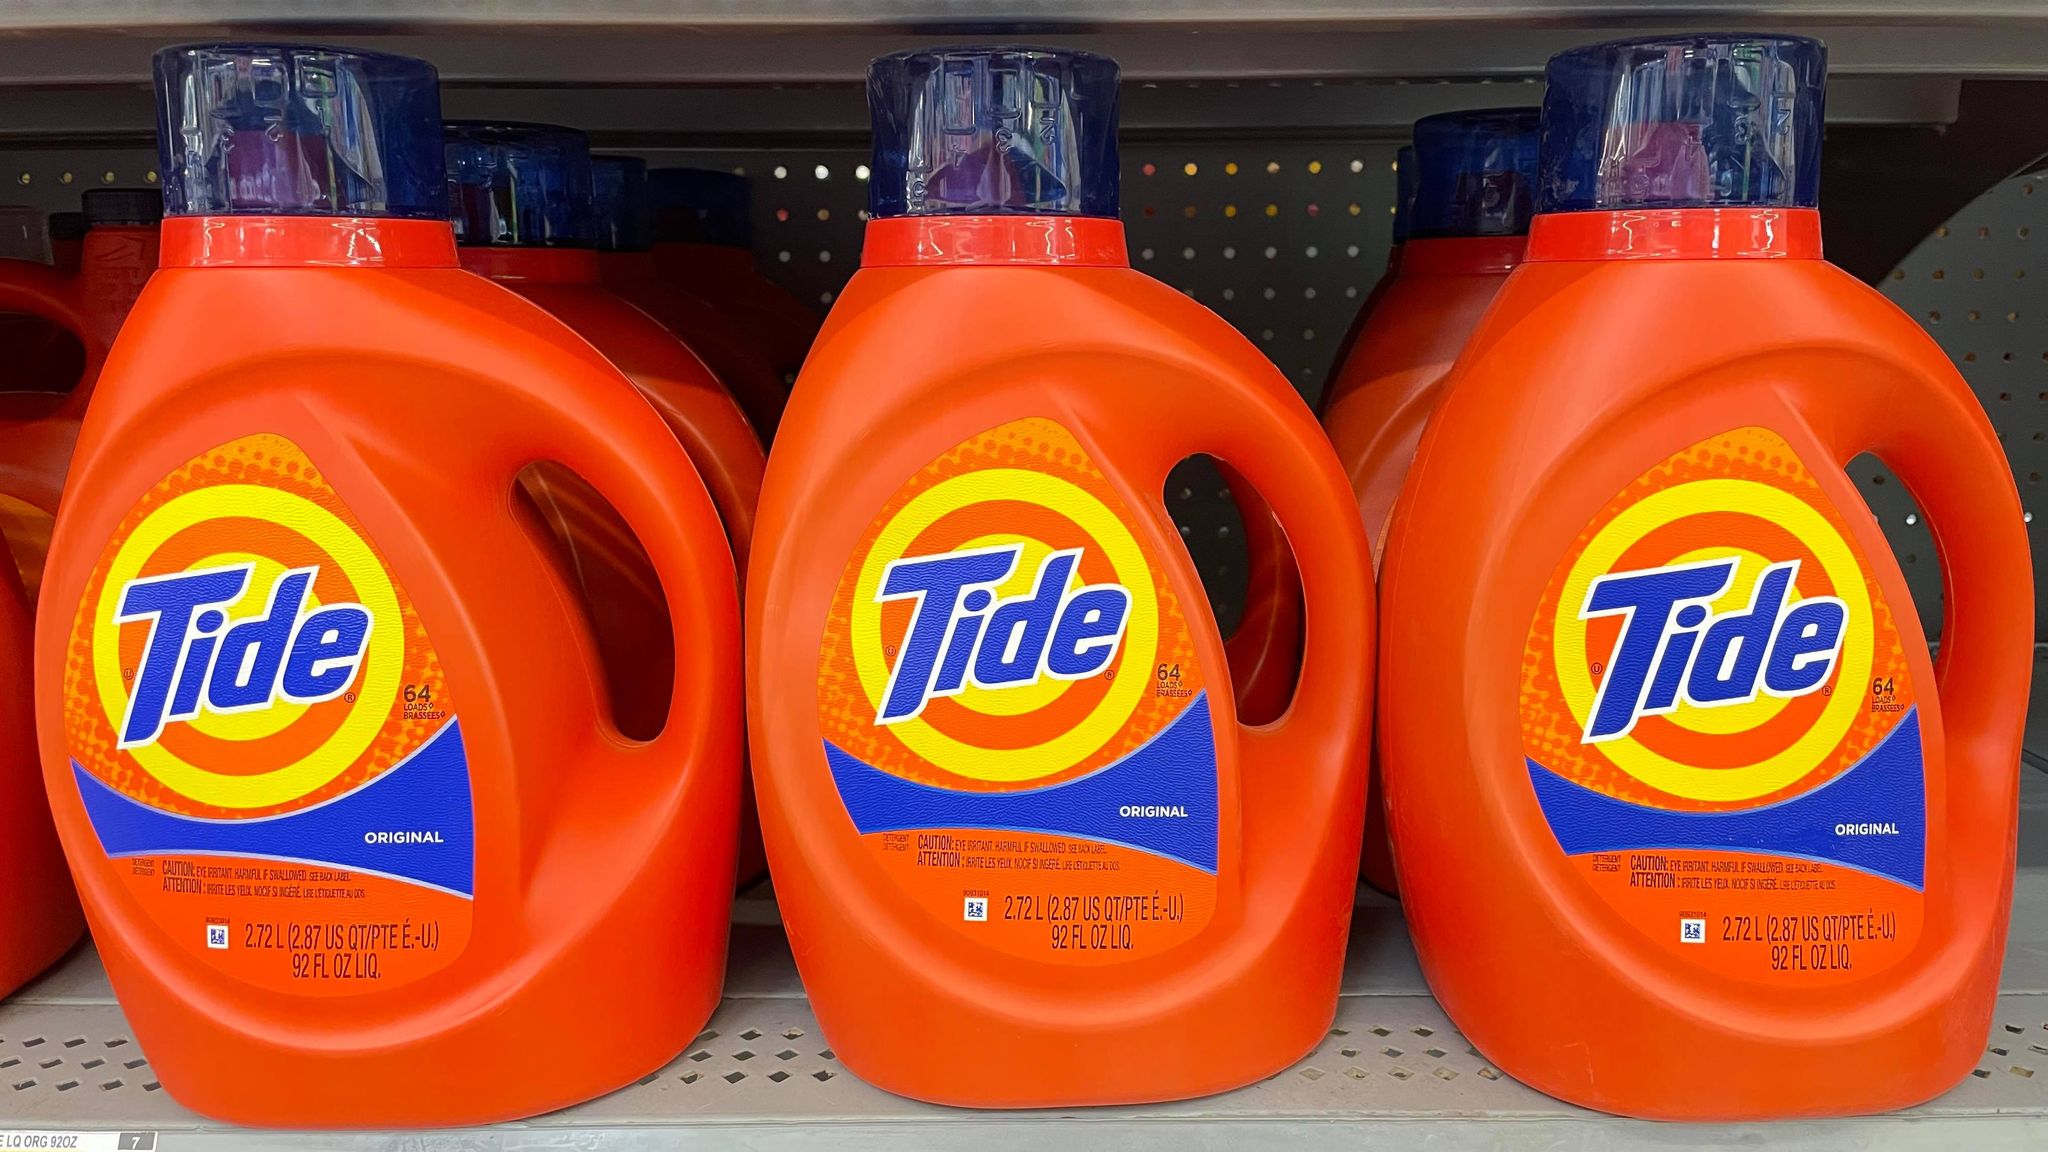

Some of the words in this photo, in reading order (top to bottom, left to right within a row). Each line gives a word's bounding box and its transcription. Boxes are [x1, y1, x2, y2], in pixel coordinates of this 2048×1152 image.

[874, 543, 1132, 725] Tide
[112, 561, 374, 750] Tide
[1578, 556, 1850, 744] Tide
[1158, 663, 1181, 681] 64
[404, 684, 431, 702] 64
[1873, 677, 1894, 695] 64
[404, 703, 428, 711] LOADS
[1119, 805, 1188, 818] ORIGINAL
[364, 831, 444, 844] ORIGINAL
[1835, 822, 1900, 836] ORIGINAL
[917, 834, 954, 851] CAUTION:
[917, 850, 961, 867] ATTENTION
[1630, 855, 1669, 871] CAUTION:
[162, 860, 195, 877] CAUTION:
[162, 876, 202, 894] ATTENTION
[1630, 871, 1676, 888] ATTENTION
[1004, 895, 1032, 920] 2.72
[1036, 896, 1044, 921] L
[1047, 894, 1079, 924] (2.87
[1082, 896, 1100, 921] US
[1104, 895, 1148, 922] QT/PTE
[245, 923, 273, 948] 2.72
[276, 924, 285, 949] L
[287, 921, 320, 952] (2.87
[324, 924, 344, 950] US
[348, 923, 399, 951] QT/PTE
[1052, 924, 1068, 949] 92
[1072, 924, 1087, 950] FL
[1091, 924, 1107, 950] OZ
[1110, 924, 1134, 951] LIQ.
[1722, 916, 1751, 941] 2.72
[1755, 917, 1763, 941] L
[1766, 914, 1798, 944] (2.87
[1802, 915, 1819, 942] US
[1822, 914, 1864, 942] QT/PTE
[293, 953, 310, 978] 92
[313, 953, 329, 979] FL
[333, 953, 351, 979] OZ
[355, 952, 382, 980] LIQ.
[1771, 945, 1788, 970] 92
[1792, 945, 1807, 970] FL
[1810, 945, 1827, 970] OZ
[1830, 944, 1852, 970] LIQ.
[6, 1135, 22, 1148] LQ
[24, 1135, 48, 1148] ORG
[131, 1136, 141, 1150] 7
